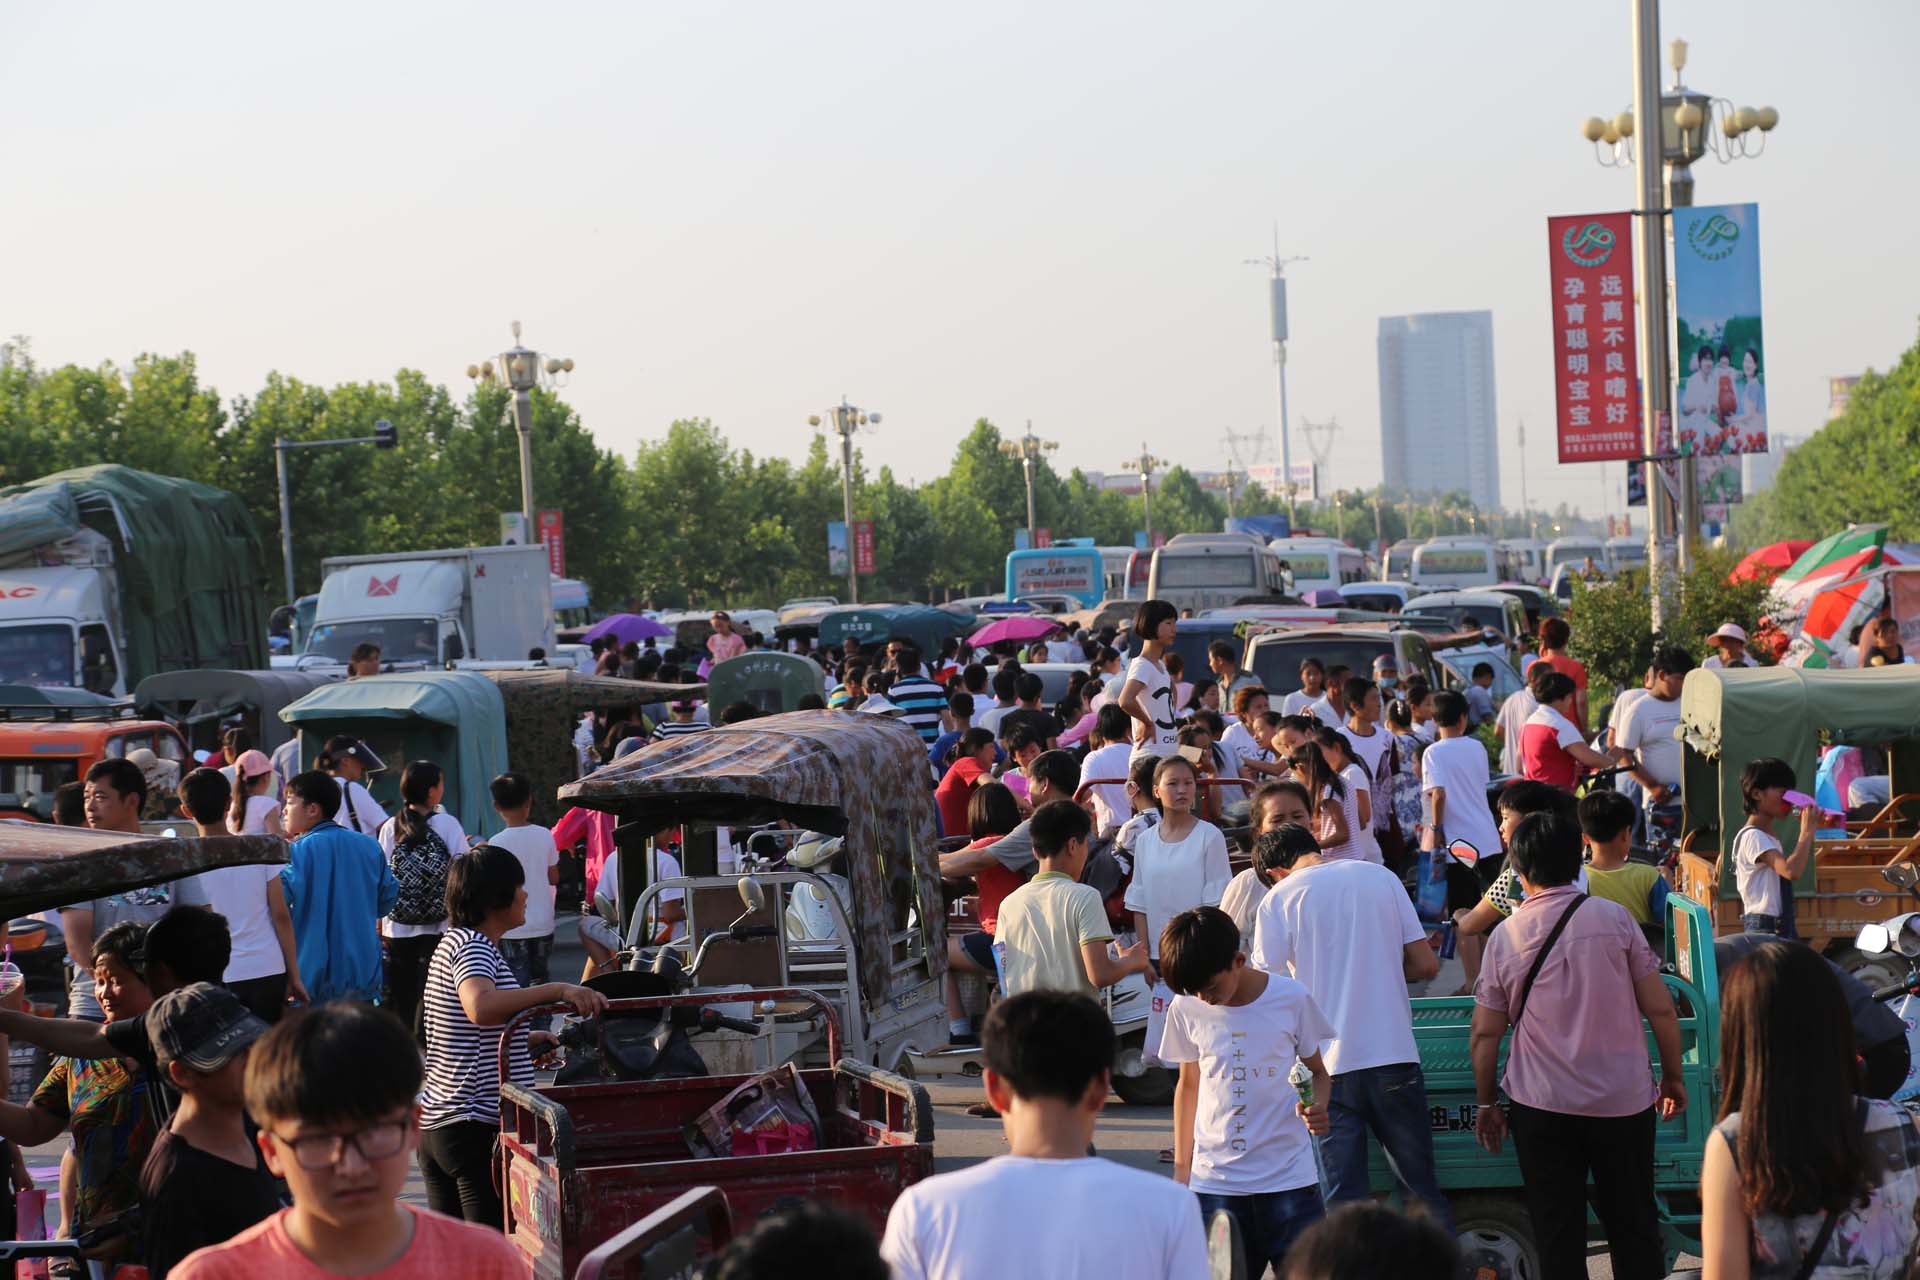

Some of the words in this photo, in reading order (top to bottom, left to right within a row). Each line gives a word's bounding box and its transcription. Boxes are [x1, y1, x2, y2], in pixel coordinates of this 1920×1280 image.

[1563, 277, 1591, 427] 孕育聪明宝宝
[1600, 275, 1629, 425] 远离不良嗜好
